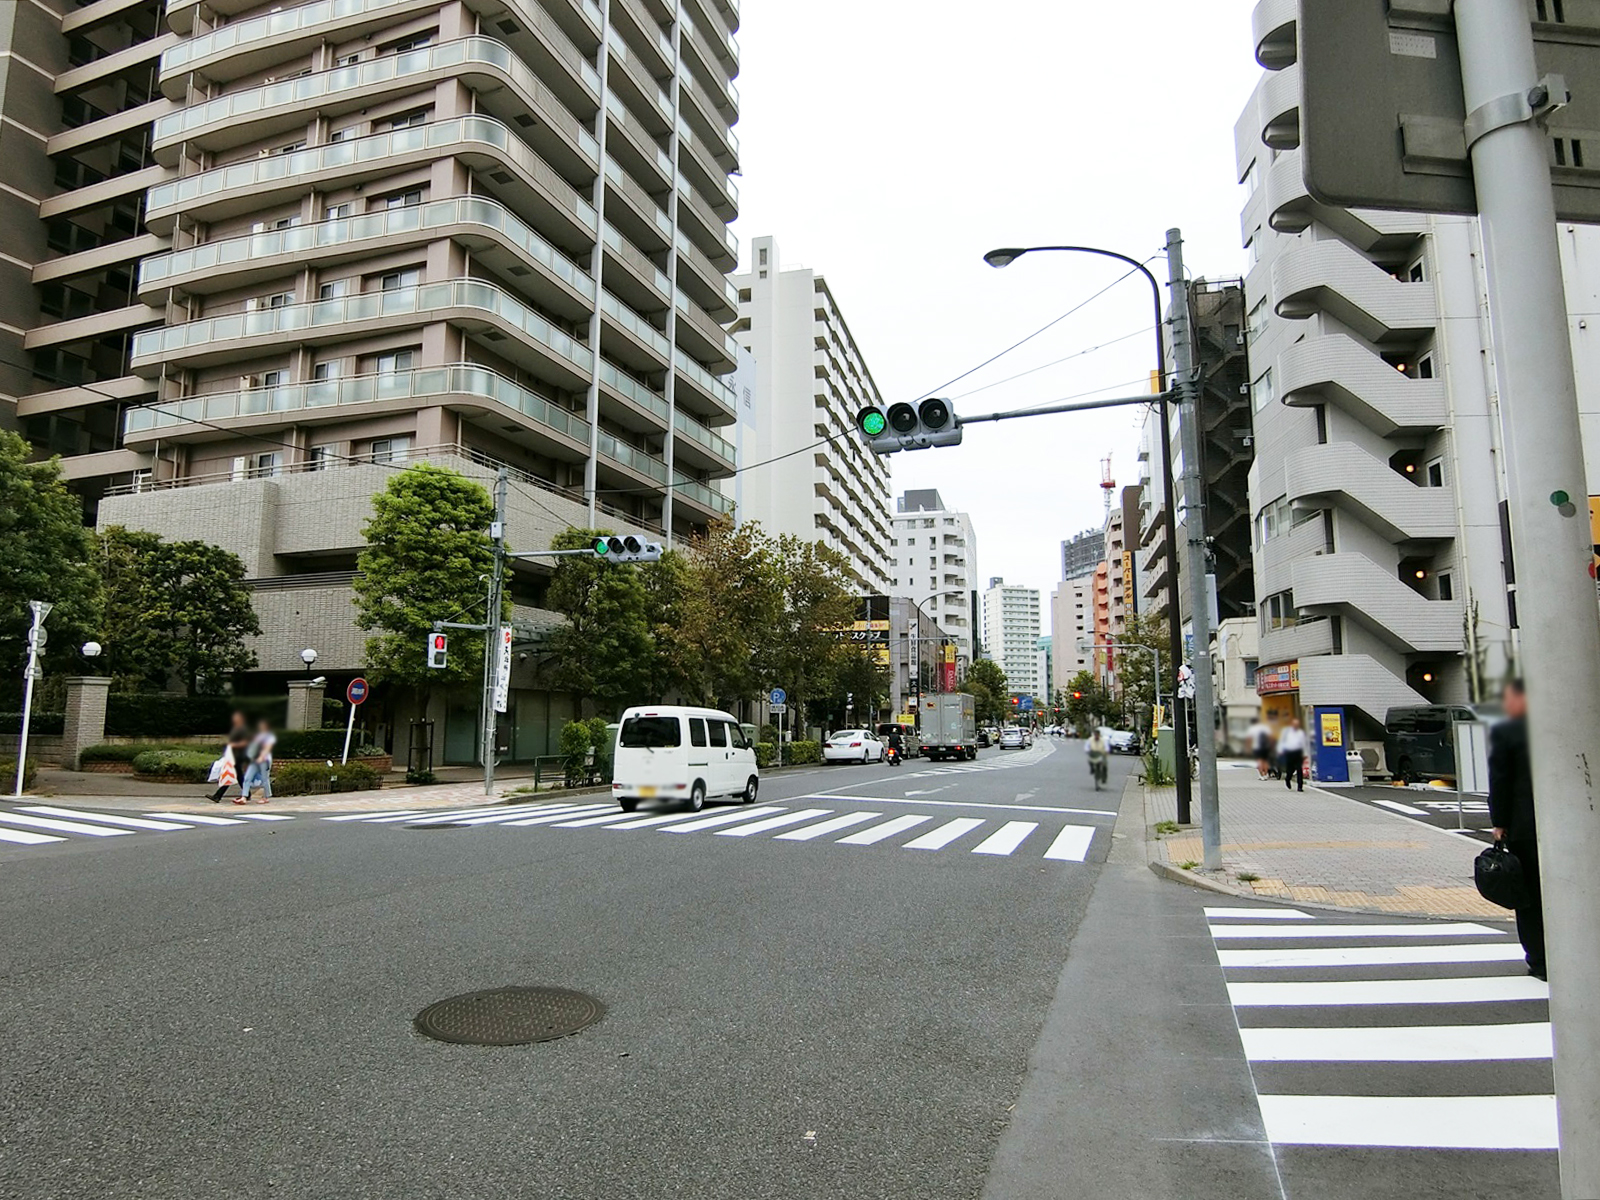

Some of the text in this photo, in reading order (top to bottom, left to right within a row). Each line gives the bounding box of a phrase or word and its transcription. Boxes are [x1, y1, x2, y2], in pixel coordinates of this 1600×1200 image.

[1124, 555, 1133, 600] スーパーホテル
